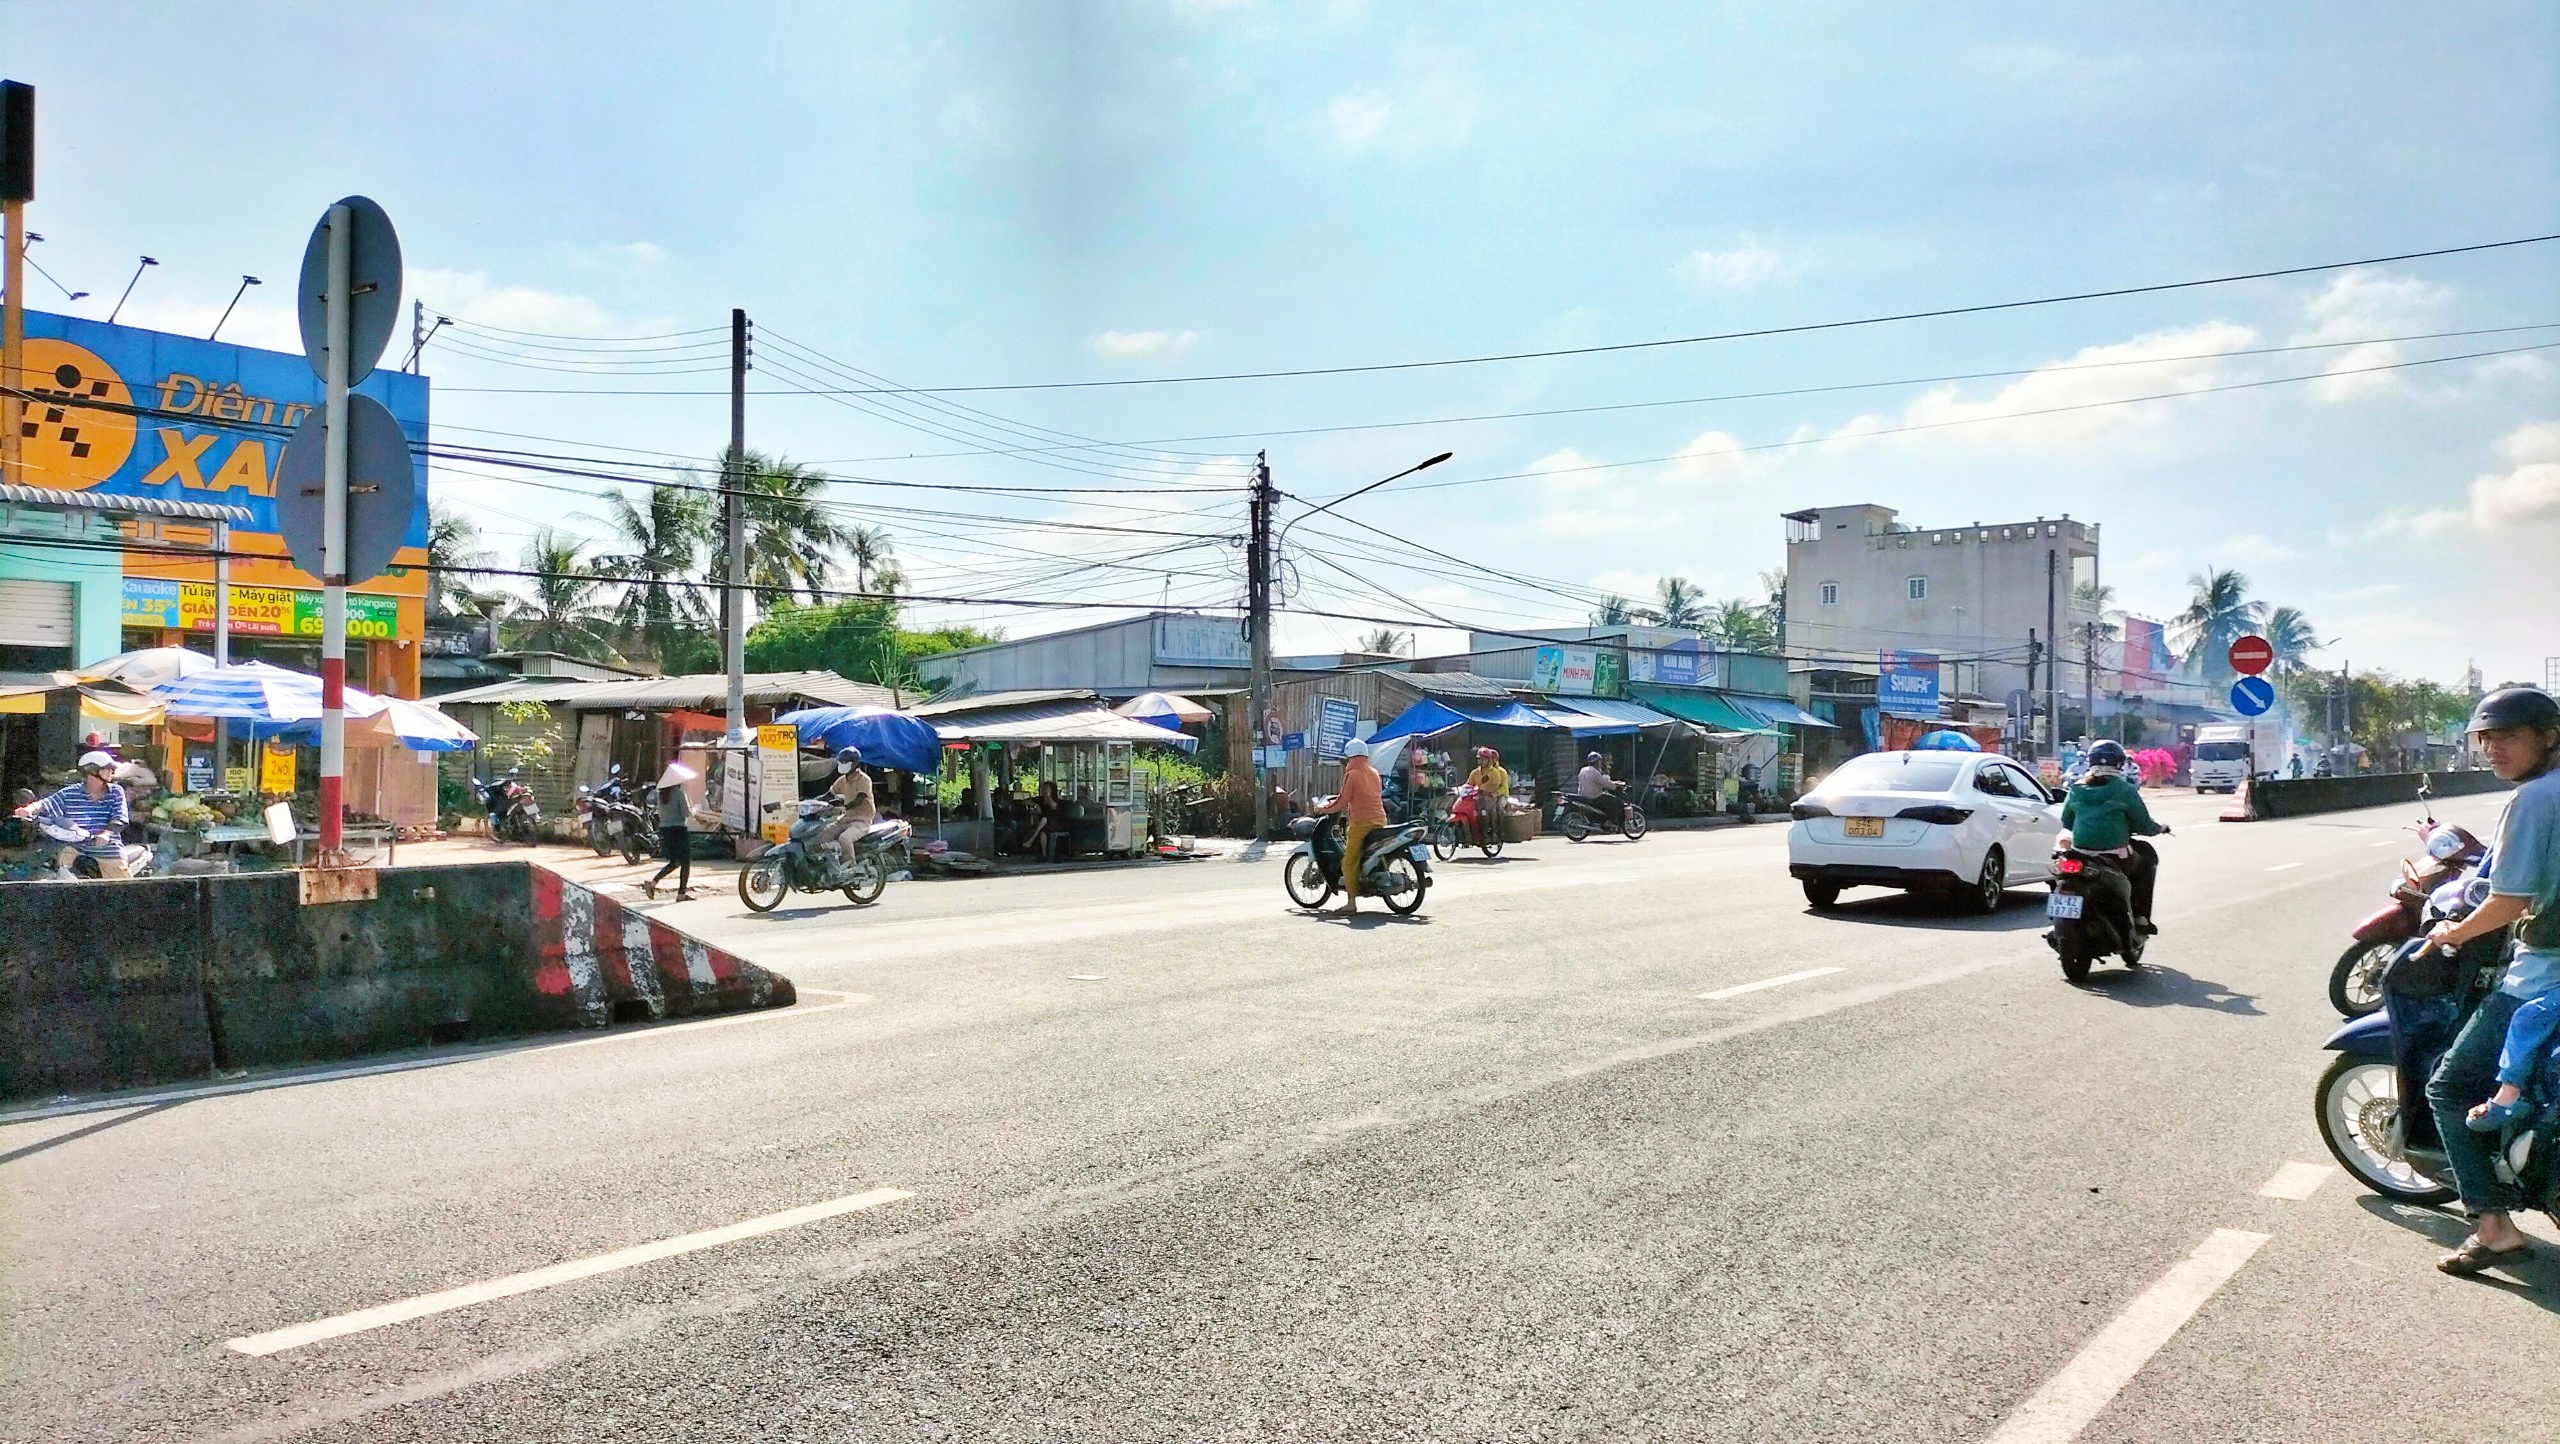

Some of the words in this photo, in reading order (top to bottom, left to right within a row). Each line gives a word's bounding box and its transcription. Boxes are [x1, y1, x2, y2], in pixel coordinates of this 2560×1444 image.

[141, 428, 284, 498] XA
[240, 589, 265, 603] Máy
[267, 589, 291, 604] giặt
[296, 595, 314, 606] Máy
[359, 598, 397, 609] Kangaroo
[260, 605, 292, 618] 20%
[1664, 654, 1677, 668] KIM
[1678, 655, 1693, 670] ANH
[1563, 667, 1580, 680] MINH
